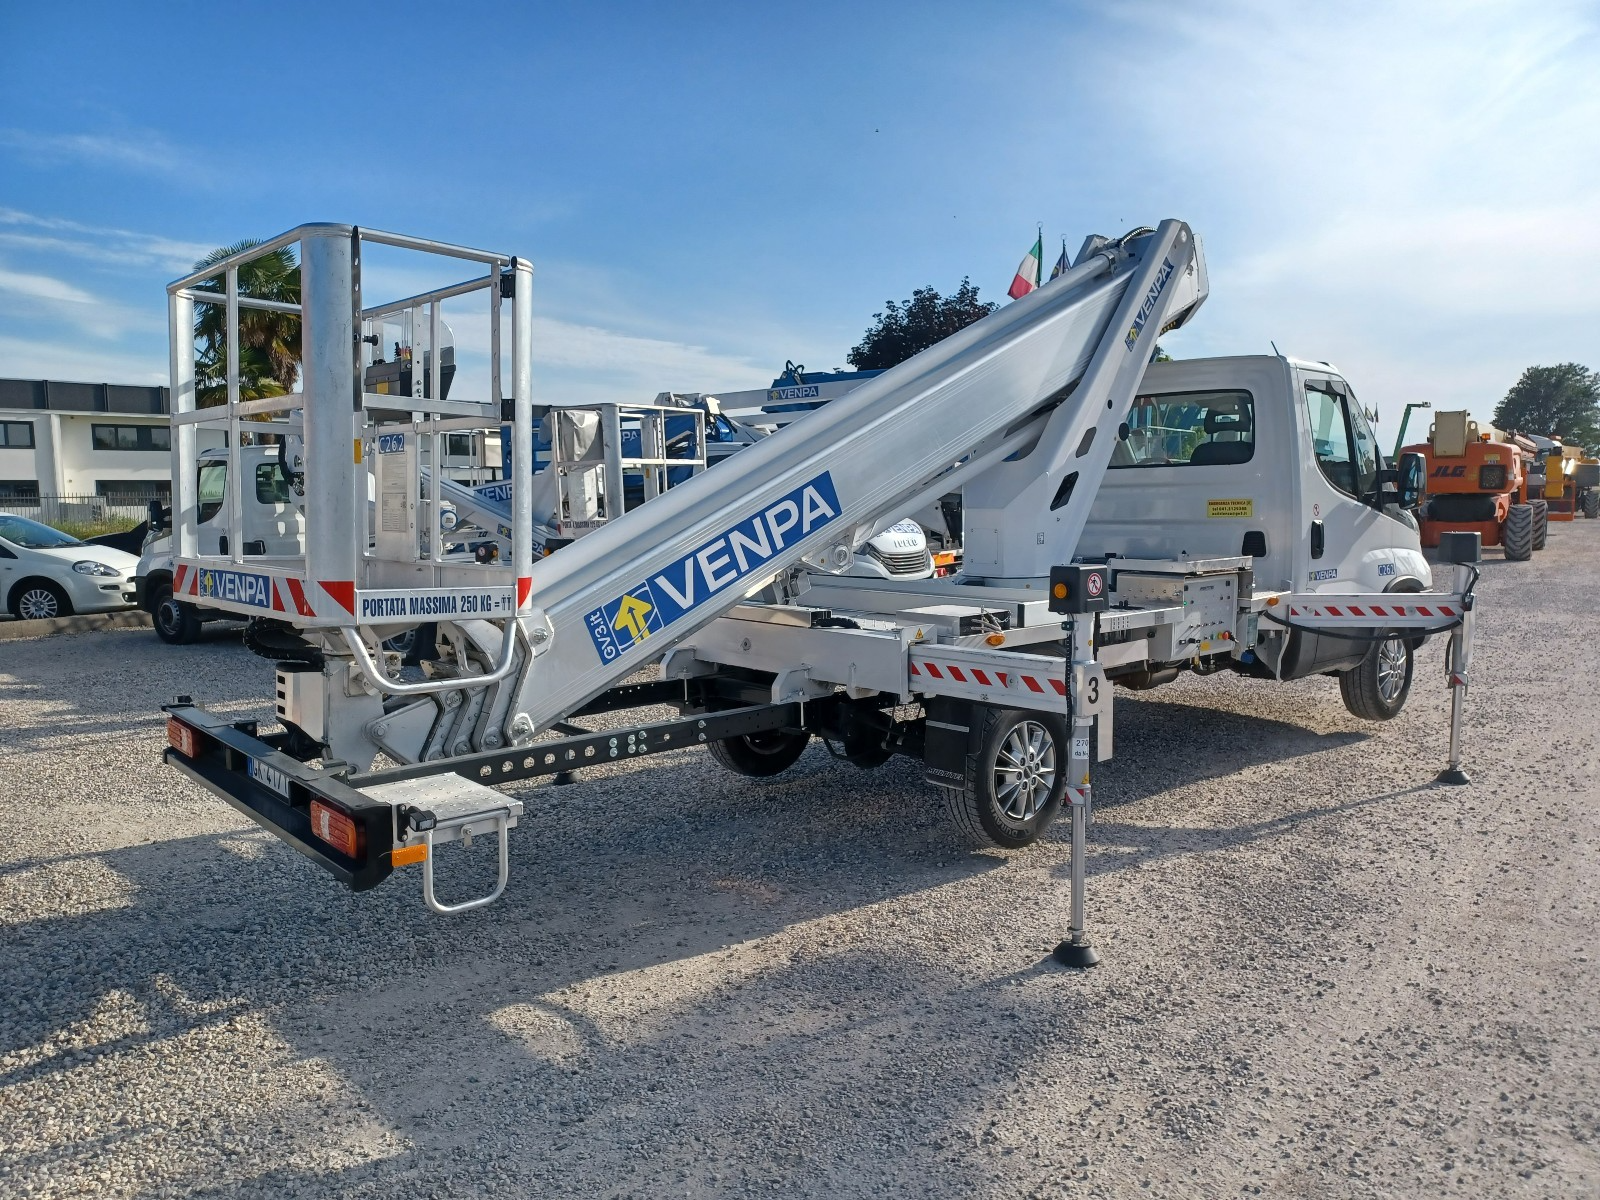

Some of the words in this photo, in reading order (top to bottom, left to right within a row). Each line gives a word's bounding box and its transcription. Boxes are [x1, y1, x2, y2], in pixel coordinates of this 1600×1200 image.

[1135, 264, 1172, 326] VENPA
[780, 387, 818, 399] VENPA
[379, 434, 404, 454] C262
[1430, 465, 1467, 478] JLG
[654, 484, 835, 610] VENPA
[1316, 569, 1337, 580] VENPA
[1378, 564, 1395, 576] C262
[214, 571, 268, 606] VENPA
[362, 596, 407, 617] PORTATA
[409, 595, 458, 616] MASSIMA
[460, 594, 478, 614] 250
[480, 594, 492, 612] KG
[1087, 676, 1099, 705] 3
